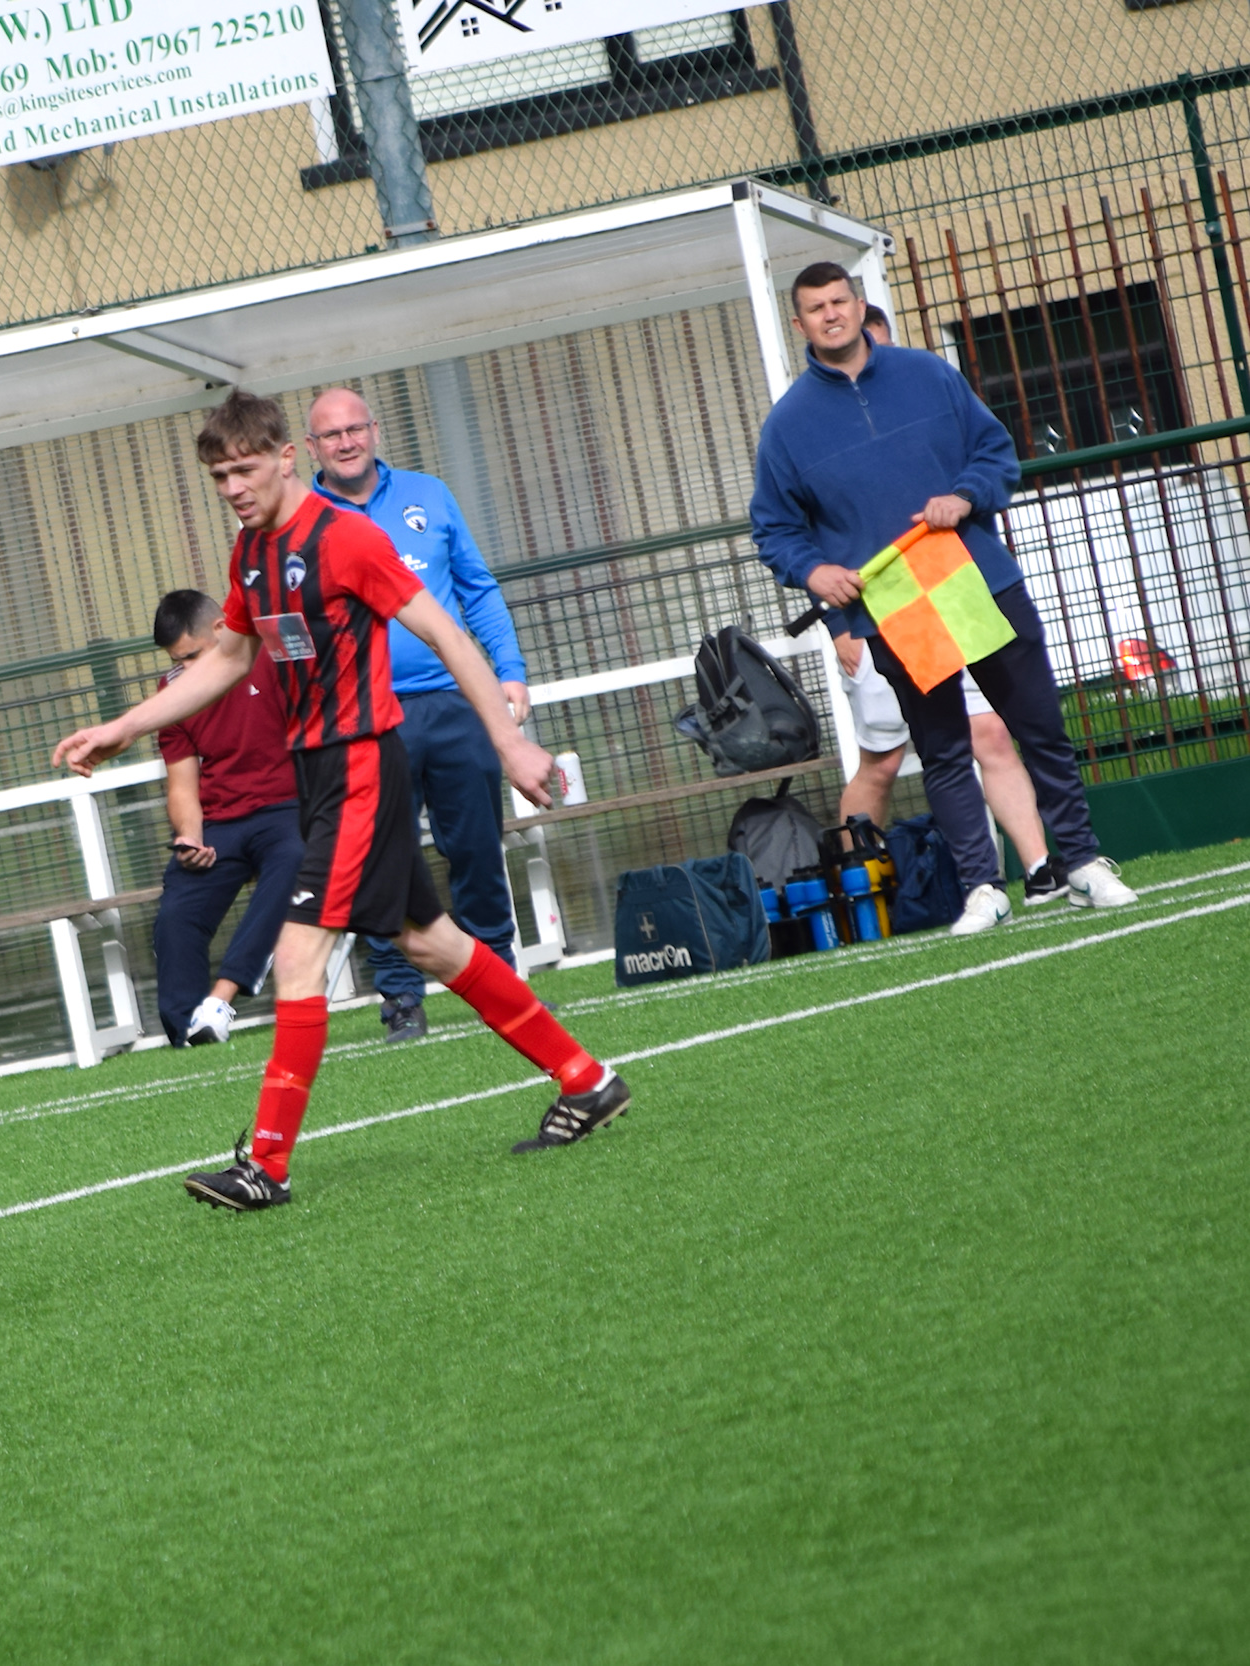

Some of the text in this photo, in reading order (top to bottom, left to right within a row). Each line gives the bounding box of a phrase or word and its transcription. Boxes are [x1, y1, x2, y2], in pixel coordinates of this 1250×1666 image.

[45, 48, 118, 84] Mob:
[125, 25, 201, 66] 07967
[211, 4, 306, 49] 225210
[61, 0, 133, 33] LTD
[24, 99, 163, 147] Mechanical
[168, 71, 320, 117] Installations
